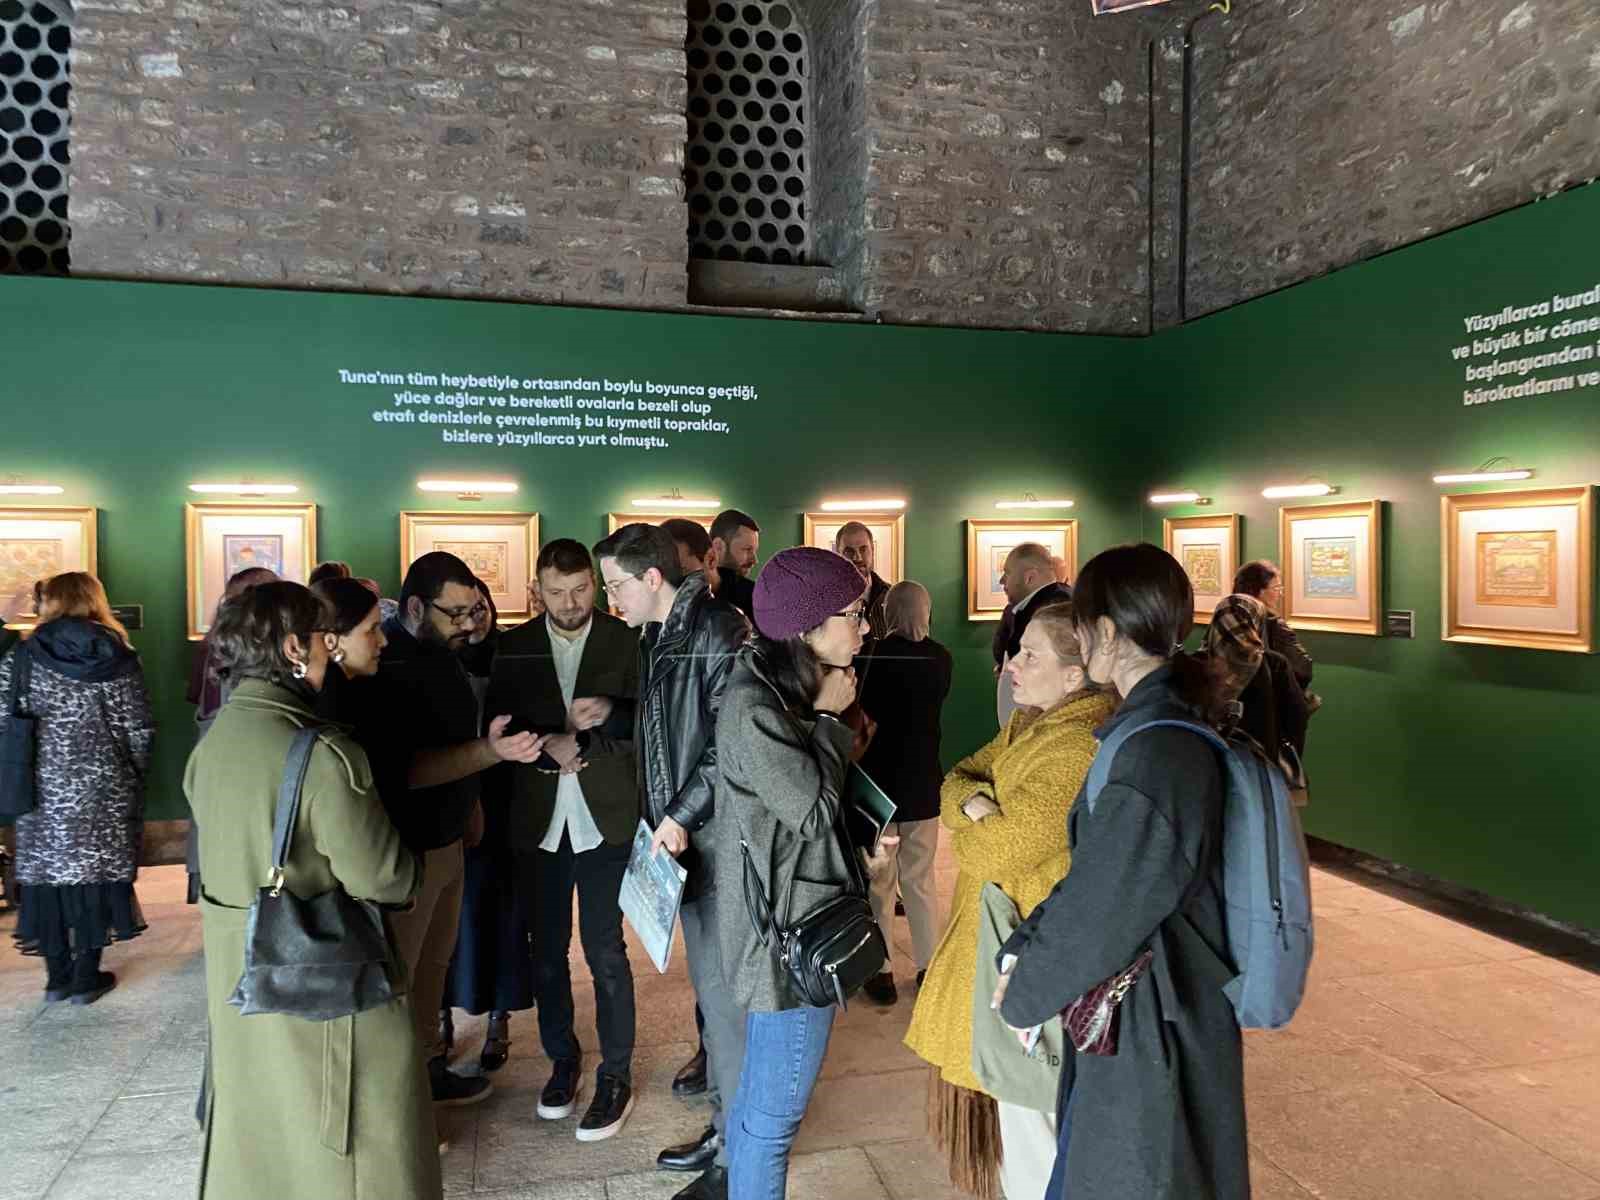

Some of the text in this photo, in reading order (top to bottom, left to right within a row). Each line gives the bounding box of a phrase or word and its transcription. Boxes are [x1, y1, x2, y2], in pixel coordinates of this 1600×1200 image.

[1464, 302, 1550, 333] Yüzyıllarca
[1452, 345, 1470, 360] ve
[1473, 331, 1521, 356] büyük
[1524, 325, 1549, 345] bir
[1466, 345, 1594, 382] başlangıcından
[338, 369, 758, 400] Tuna'nın tüm heybetiyle ortasından boylu boyunca geçtiği,
[1464, 371, 1600, 406] bürokratlarını ve
[394, 391, 711, 416] yüce dağlar ve bereketli ovalarla bezeli olup
[372, 409, 729, 433] etrafı denizlerle çevrelenmiş bu kıymetli topraklar,
[443, 429, 669, 450] bizlere yüzyıllarca yurt olmuştu.
